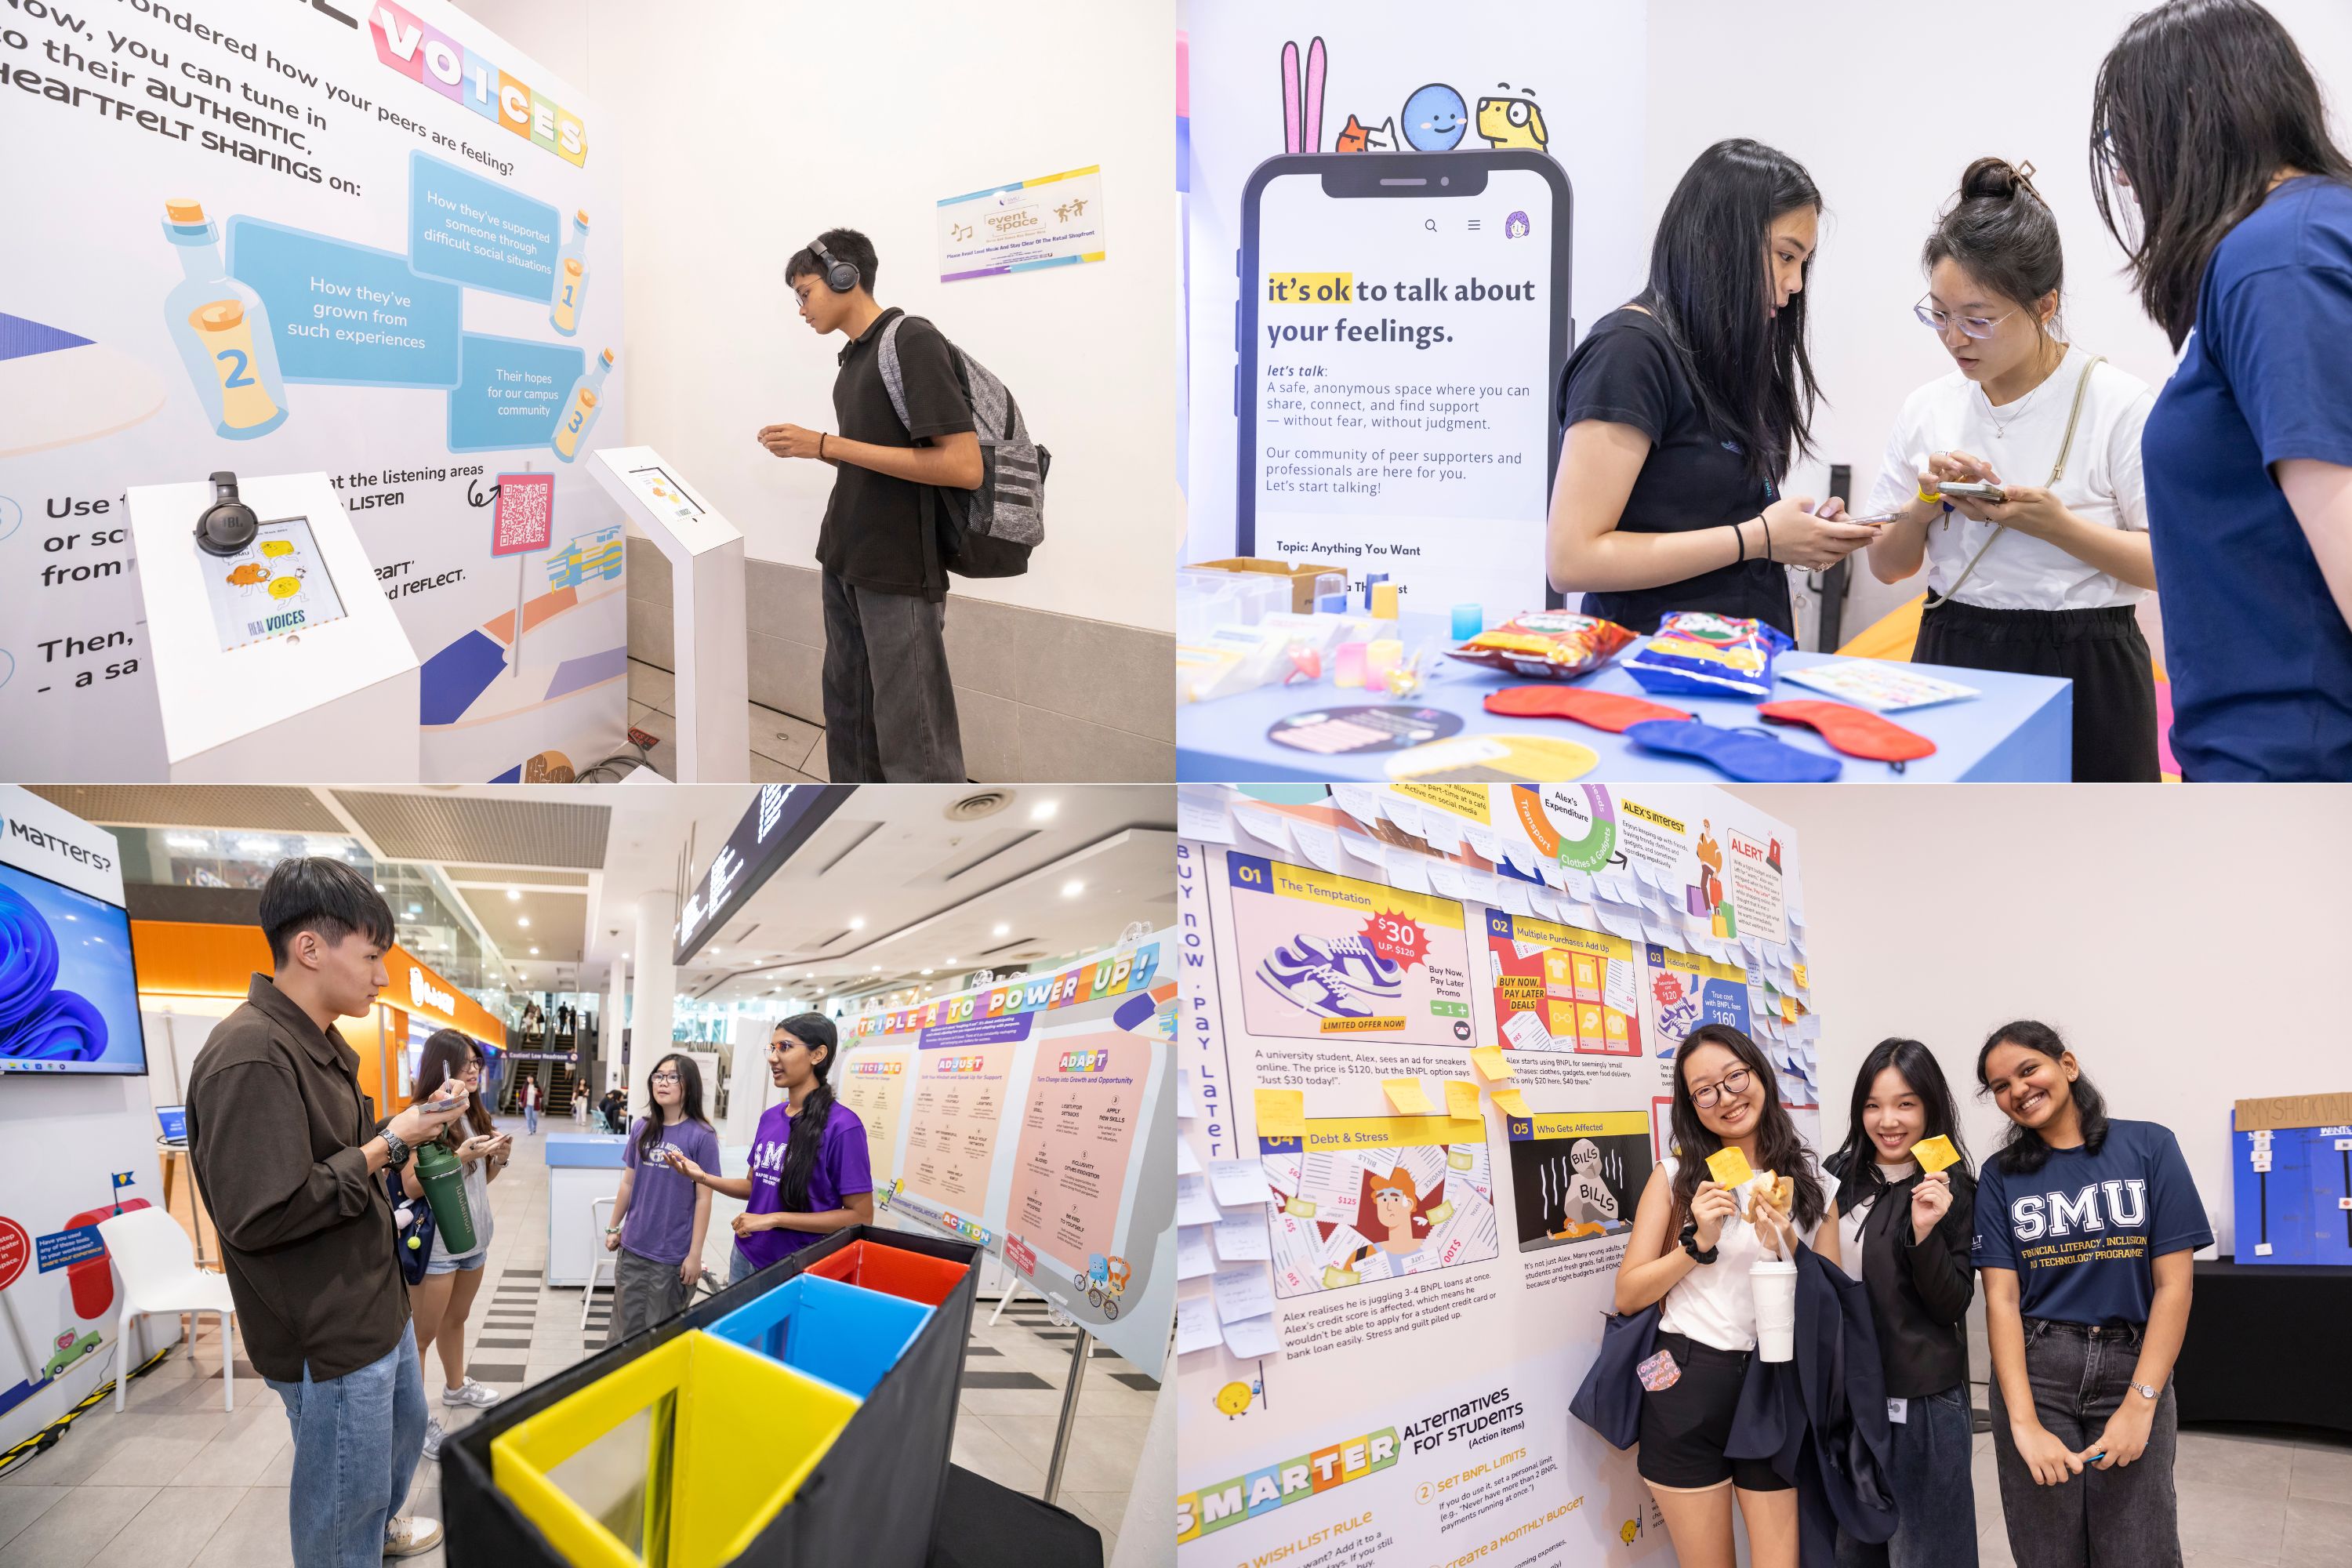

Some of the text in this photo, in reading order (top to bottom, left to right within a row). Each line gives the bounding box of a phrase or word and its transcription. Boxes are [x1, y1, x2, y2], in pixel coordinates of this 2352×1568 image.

[130, 0, 514, 176] ondered how your peers are feeling?
[378, 5, 583, 156] VOICES
[427, 190, 549, 243] How they've supported
[988, 210, 1027, 225] event
[996, 217, 1038, 232] space
[445, 219, 536, 254] someone through
[424, 229, 551, 274] difficult social situations
[562, 285, 573, 308] 1
[1269, 277, 1534, 301] it's ok to talk about
[1267, 318, 1453, 350] your feelings.
[217, 350, 256, 389] 2
[495, 368, 551, 385] Their hopes
[1267, 365, 1327, 376] let's talk:
[487, 386, 503, 397] for
[524, 390, 558, 401] campus
[1267, 381, 1529, 398] A safe, anonymous space where you can
[498, 405, 550, 417] community
[1267, 397, 1479, 415] share, connect, and find support
[1283, 414, 1490, 431] without fear, without judgment.
[1266, 480, 1380, 496] Let's start talking!
[1276, 540, 1420, 556] Topic: Anything You Want
[248, 610, 305, 636] REAL VOICES
[1555, 791, 1577, 806] Alex's
[1545, 799, 1588, 822] Expenditure
[1521, 799, 1551, 851] Transport
[1561, 855, 1590, 868] Clothes
[1595, 827, 1610, 859] Gadgets
[1732, 838, 1763, 862] ALERT
[1239, 866, 1261, 884] 01
[1279, 877, 1370, 905] The Temptation
[1378, 918, 1414, 946] $30
[1492, 920, 1508, 934] 02
[1516, 927, 1609, 953] Multiple Purchases Add Up
[1378, 941, 1414, 956] U.P. $120
[1650, 952, 1662, 963] 03
[1666, 956, 1700, 970] Hidden Costs
[1428, 965, 1463, 977] Buy Now,
[1430, 976, 1464, 987] Pay Later
[1517, 978, 1538, 987] NOW,
[1436, 987, 1460, 996] Promo
[859, 1014, 917, 1033] TRIPLE
[927, 1007, 936, 1023] A
[950, 999, 975, 1018] TO
[989, 976, 1078, 1011] POWER
[1511, 1000, 1534, 1009] DEALS
[1323, 1019, 1404, 1029] LIMITED OFFER NOW!
[851, 1064, 901, 1073] ANTICIPATE
[939, 1058, 982, 1069] ADJUST
[1060, 1053, 1106, 1068] ADAPT
[1098, 1076, 1133, 1085] Opportunity
[1283, 1075, 1303, 1084] $30
[1513, 1123, 1529, 1134] 05
[1574, 1123, 1602, 1131] Affected
[1310, 1132, 1388, 1144] Debt & Stress
[1571, 1148, 1598, 1165] BILLS
[1338, 1196, 1357, 1206] $125
[1580, 1184, 1615, 1211] BILLS
[2012, 1179, 2146, 1242] SMU
[67, 1231, 82, 1240] used
[943, 1214, 989, 1243] ACTION
[2107, 1236, 2147, 1247] INCLUSION
[47, 1251, 62, 1260] your
[2042, 1253, 2093, 1267] TECHNOLOGY
[1468, 1420, 1524, 1449] (Action items)
[1177, 1435, 1395, 1534] SMARTER
